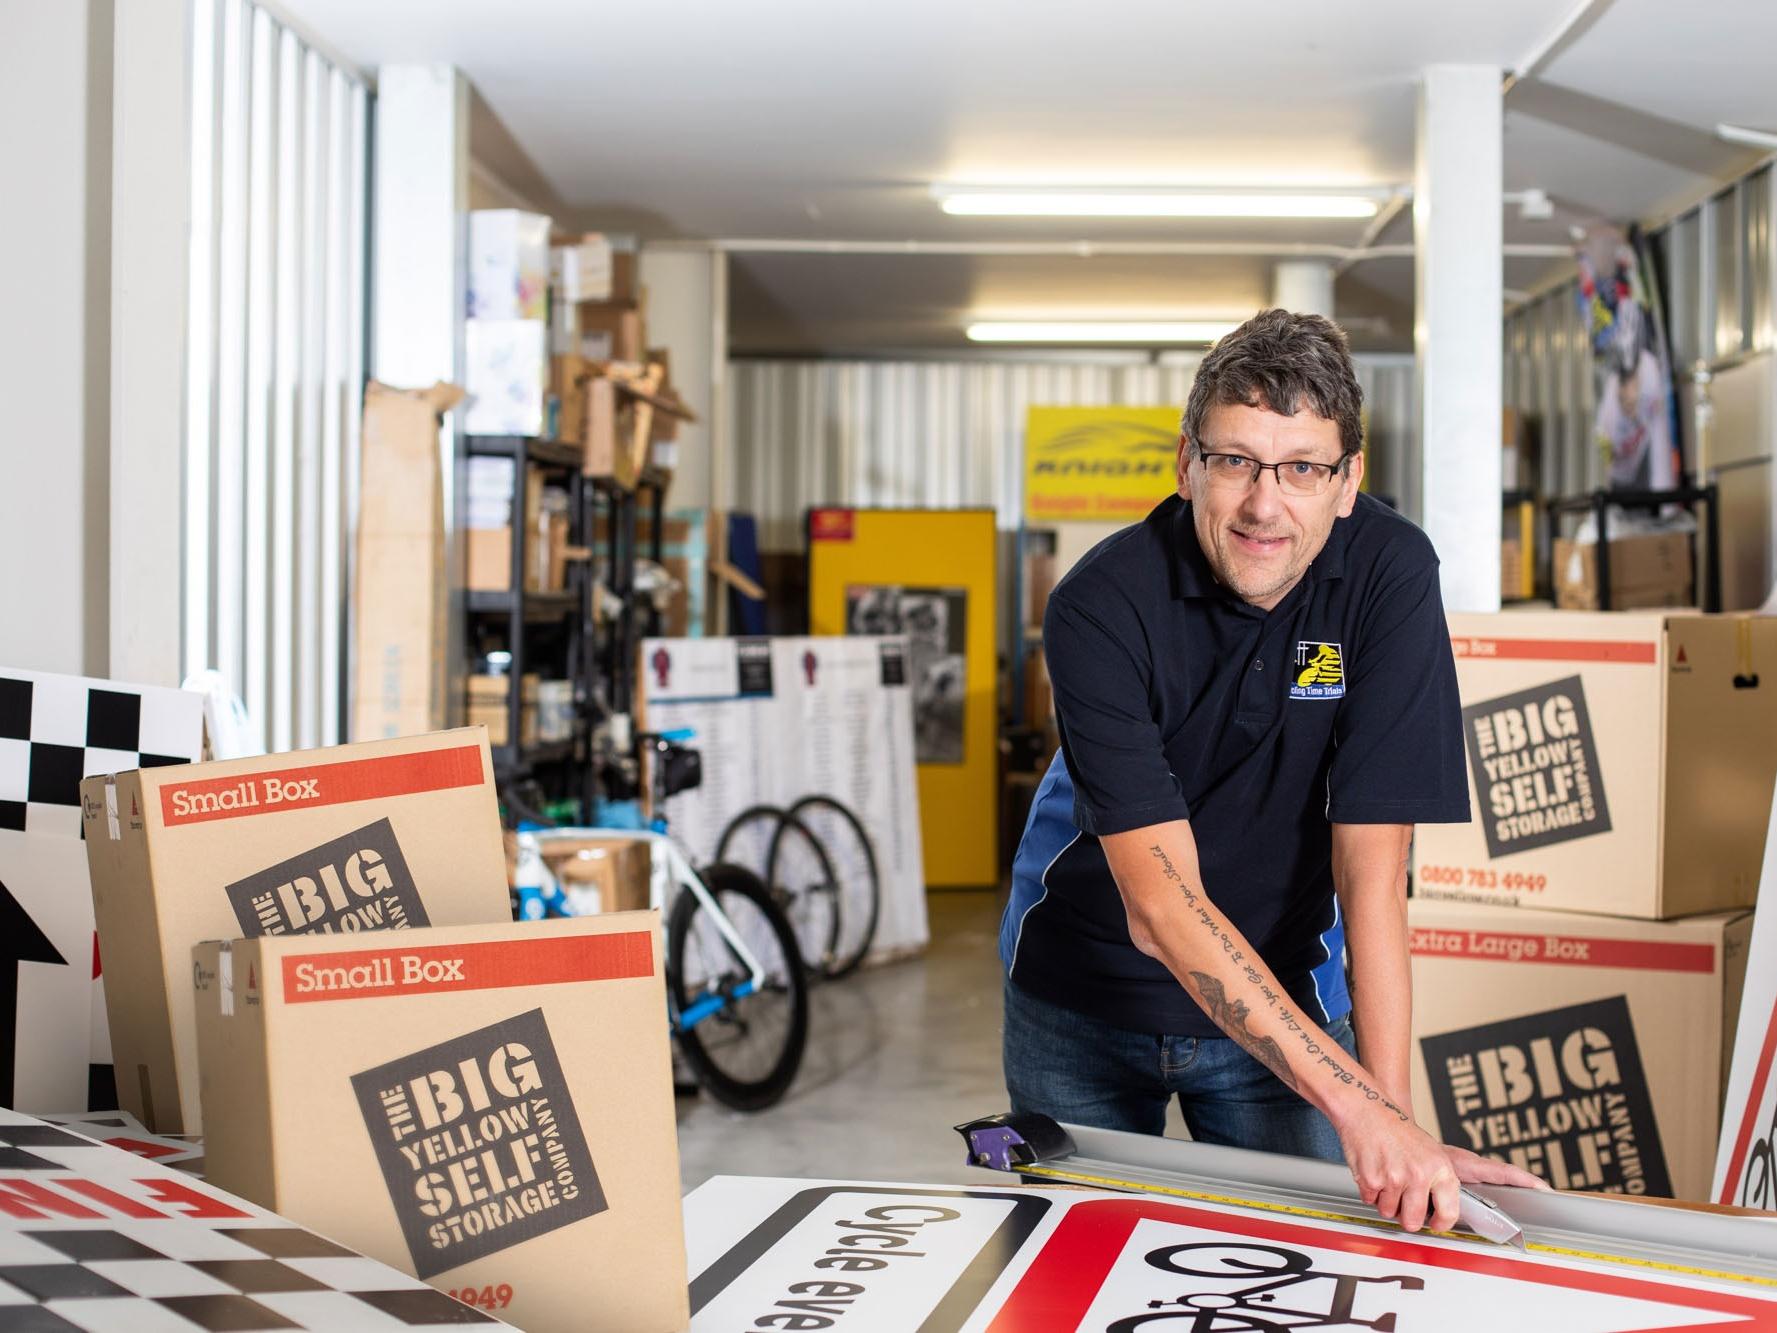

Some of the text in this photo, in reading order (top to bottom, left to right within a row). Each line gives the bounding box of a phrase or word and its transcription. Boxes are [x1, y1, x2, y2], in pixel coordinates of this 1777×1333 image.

[1290, 686, 1343, 697] cling Time Trials
[1473, 714, 1497, 759] THE
[1491, 694, 1579, 754] BIG
[1483, 738, 1570, 783] YELLOW
[1567, 738, 1597, 822] COMPANY
[172, 778, 320, 816] Small Box
[1489, 763, 1575, 818] SELF
[1495, 801, 1583, 843] STORAGE
[276, 848, 393, 930] BIG
[1149, 844, 1182, 882] Should
[1419, 865, 1463, 887] 0800
[1502, 871, 1547, 893] 4949
[252, 891, 286, 937] THE
[1196, 907, 1220, 937] What
[296, 955, 465, 993] Small Box
[1467, 932, 1539, 961] Large
[1544, 937, 1590, 960] Box
[409, 1042, 544, 1131] BIG
[1446, 1053, 1482, 1117] THE
[1477, 1027, 1622, 1110] BIG
[379, 1084, 417, 1142] THE
[399, 1103, 529, 1172] YELLOW
[1462, 1094, 1604, 1151] YELLOW
[531, 1097, 579, 1200] COMPANY
[1482, 1131, 1613, 1191] ELF
[1603, 1091, 1647, 1196] OMPANY
[414, 1133, 541, 1217] SELF
[428, 1180, 560, 1249] STORAGE
[813, 1204, 961, 1272] Cycle
[744, 1281, 866, 1333] eve
